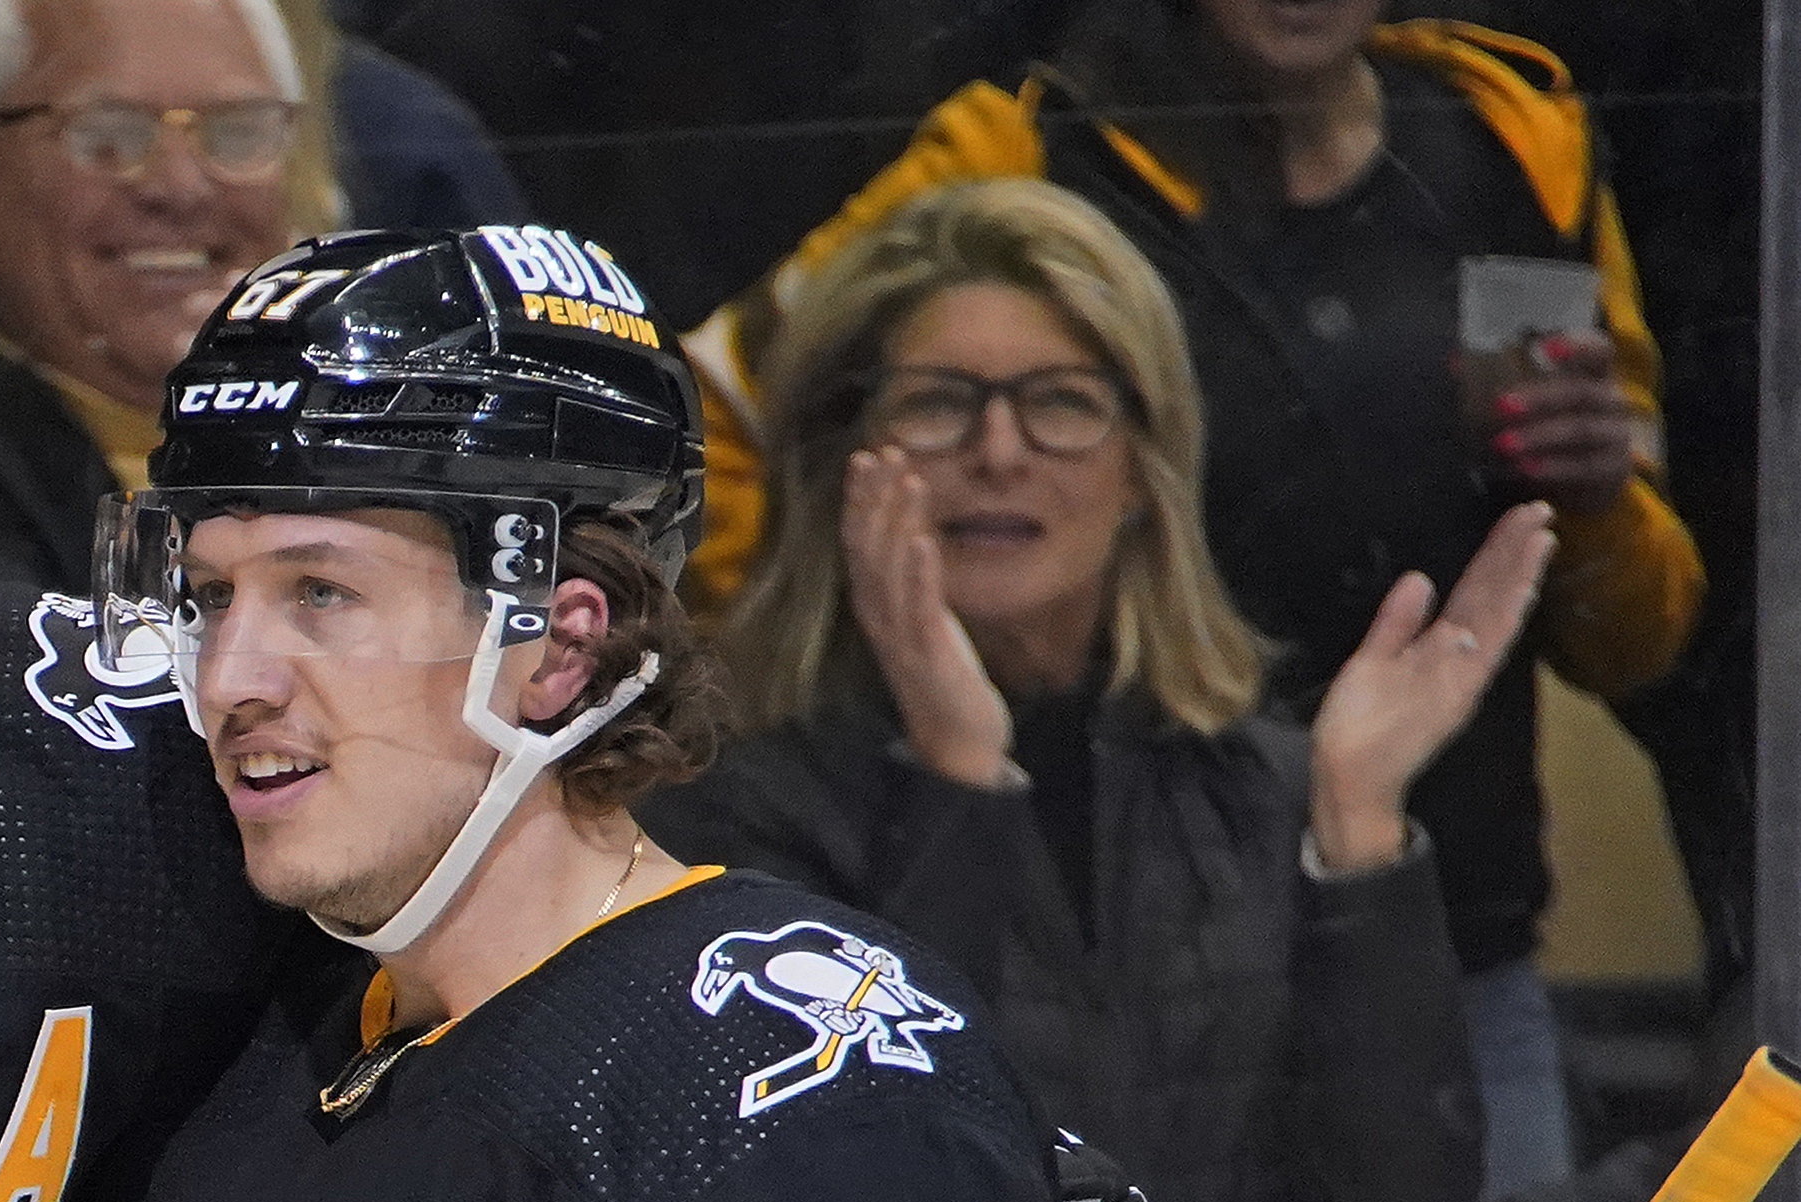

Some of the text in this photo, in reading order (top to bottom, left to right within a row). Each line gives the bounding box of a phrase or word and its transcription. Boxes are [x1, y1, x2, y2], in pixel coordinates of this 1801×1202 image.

[226, 269, 350, 321] 67
[477, 225, 646, 314] BOLD
[521, 292, 660, 349] PENGUIN
[178, 381, 299, 413] CCM
